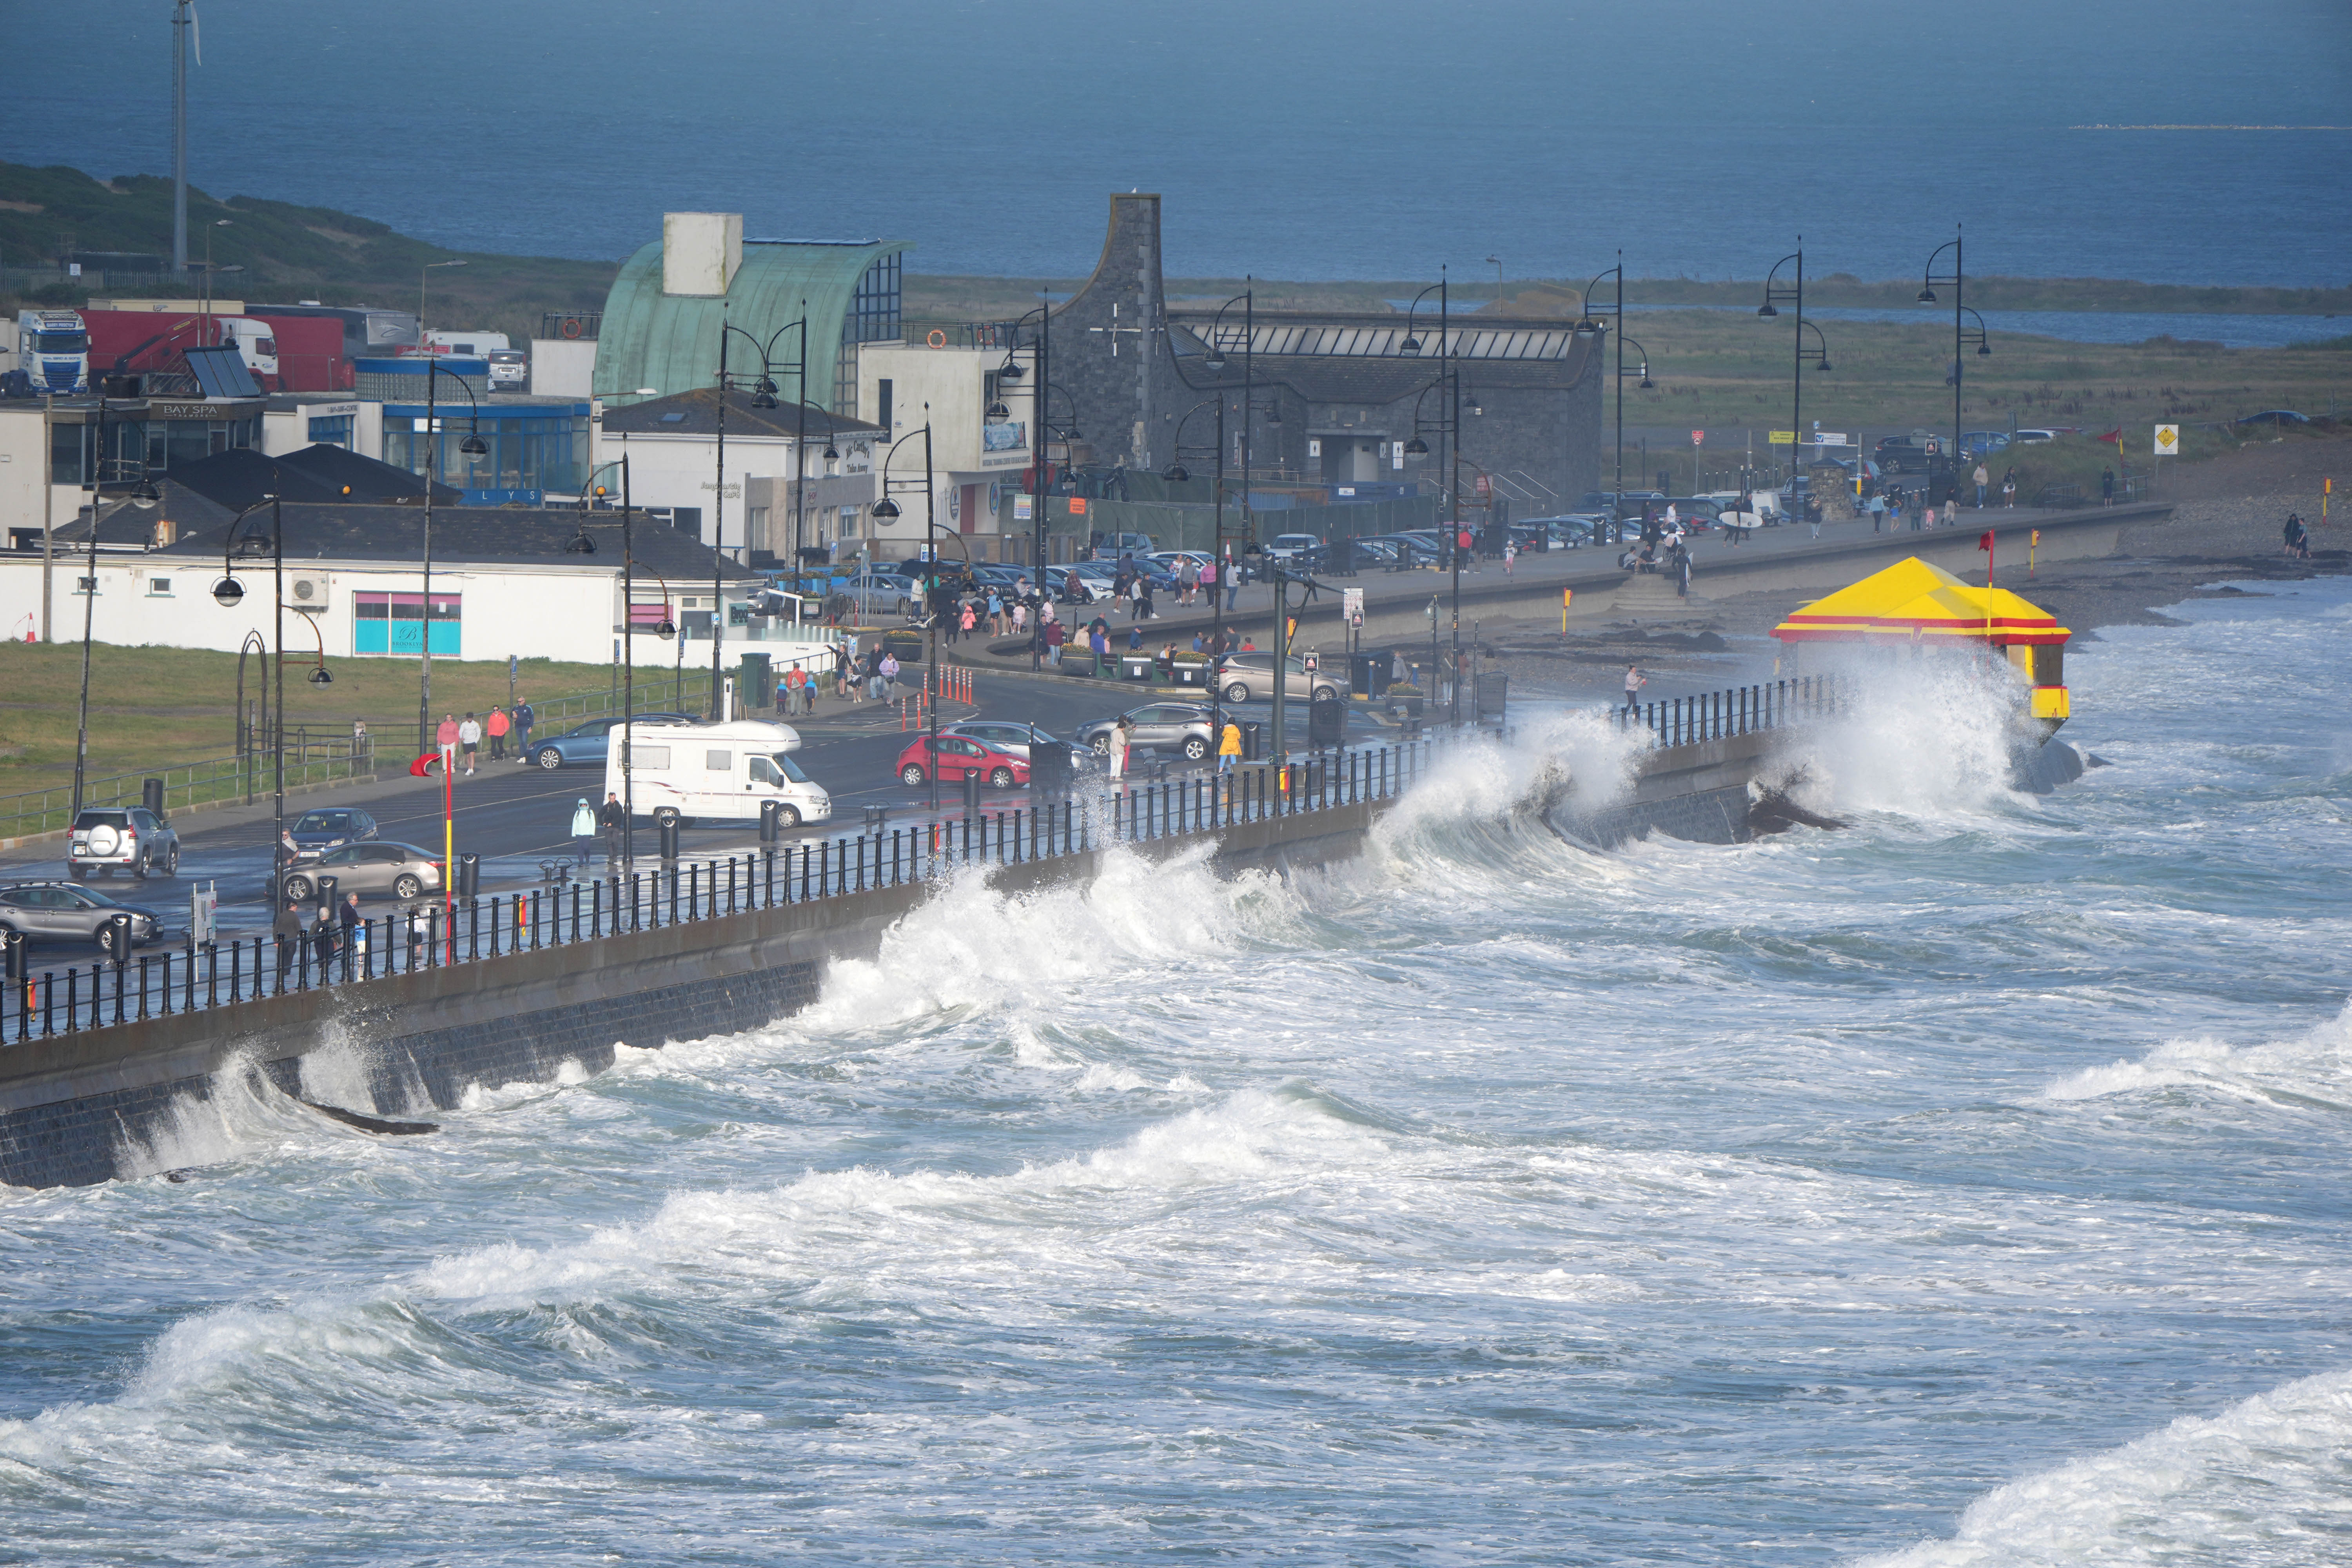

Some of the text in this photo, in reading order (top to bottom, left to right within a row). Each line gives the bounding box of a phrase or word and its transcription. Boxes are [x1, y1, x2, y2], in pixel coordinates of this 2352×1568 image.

[164, 405, 188, 414] BAY
[847, 463, 868, 474] Take Away
[701, 481, 741, 491] Sandastle
